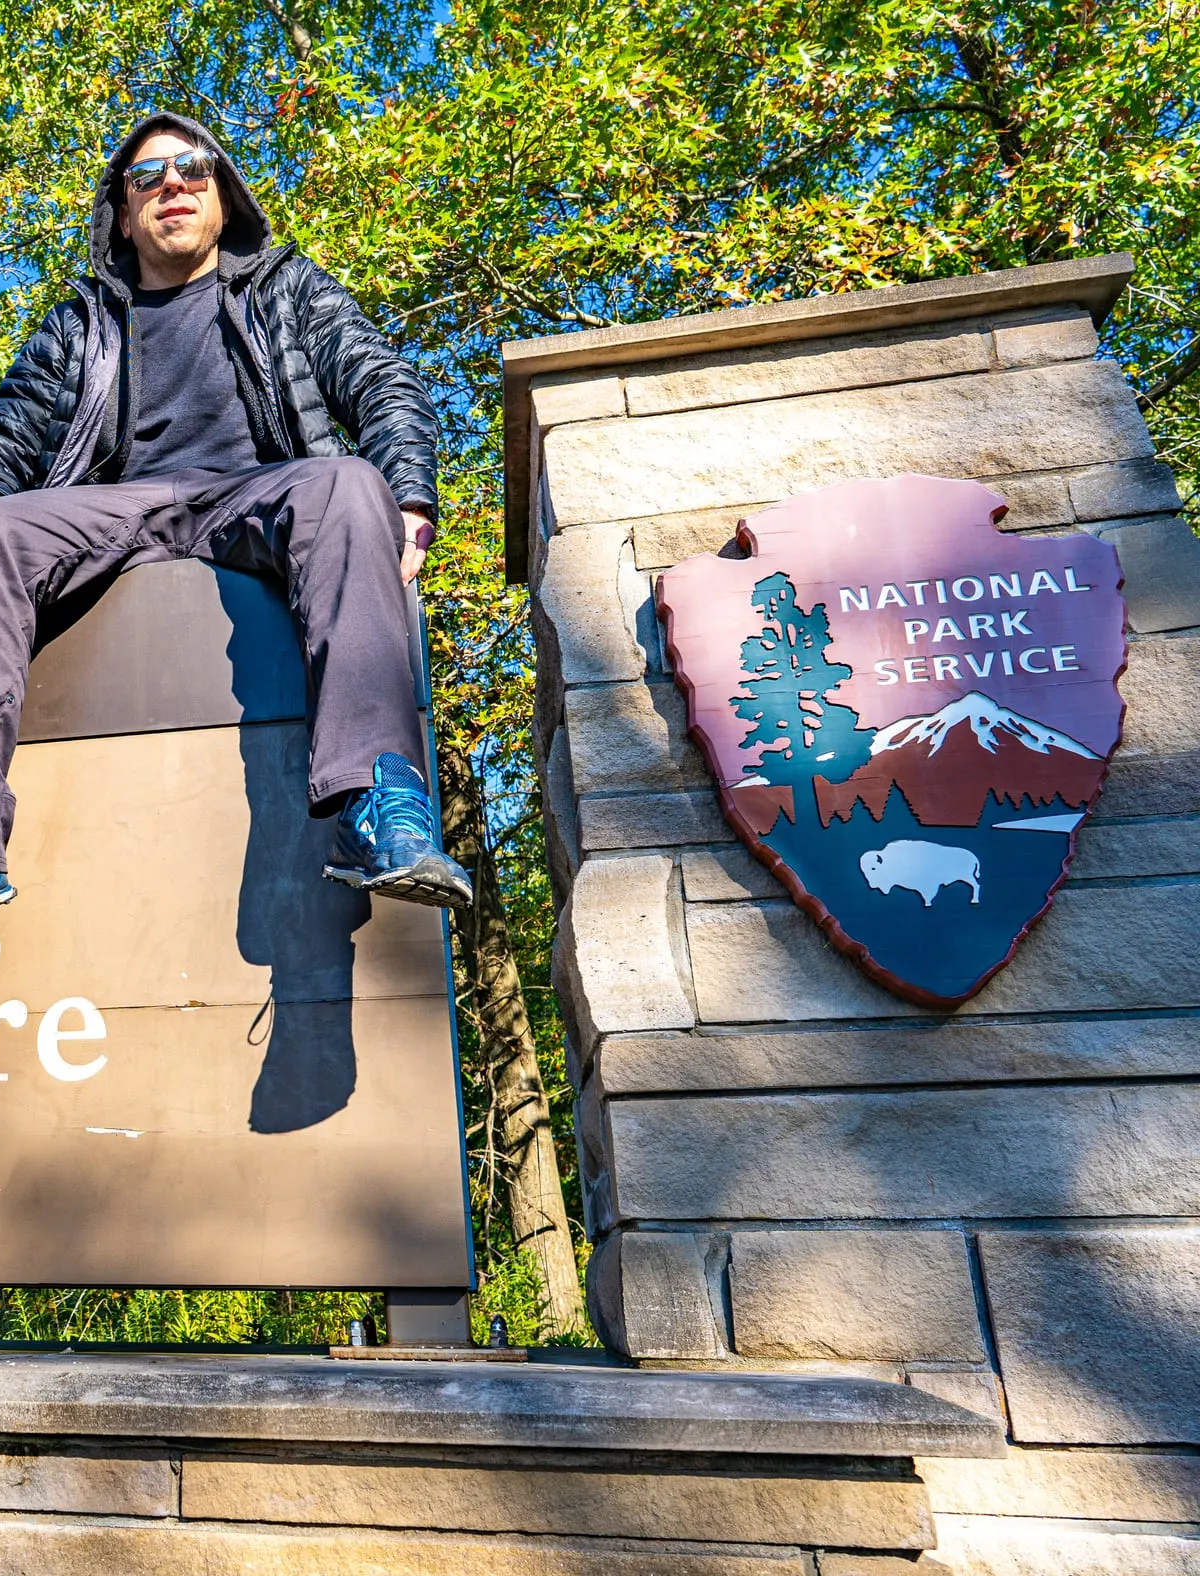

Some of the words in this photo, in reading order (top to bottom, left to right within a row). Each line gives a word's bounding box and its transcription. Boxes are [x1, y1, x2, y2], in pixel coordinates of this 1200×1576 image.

[839, 565, 1092, 613] NATIONAL
[903, 608, 1034, 645] PARK
[874, 643, 1080, 687] SERVICE
